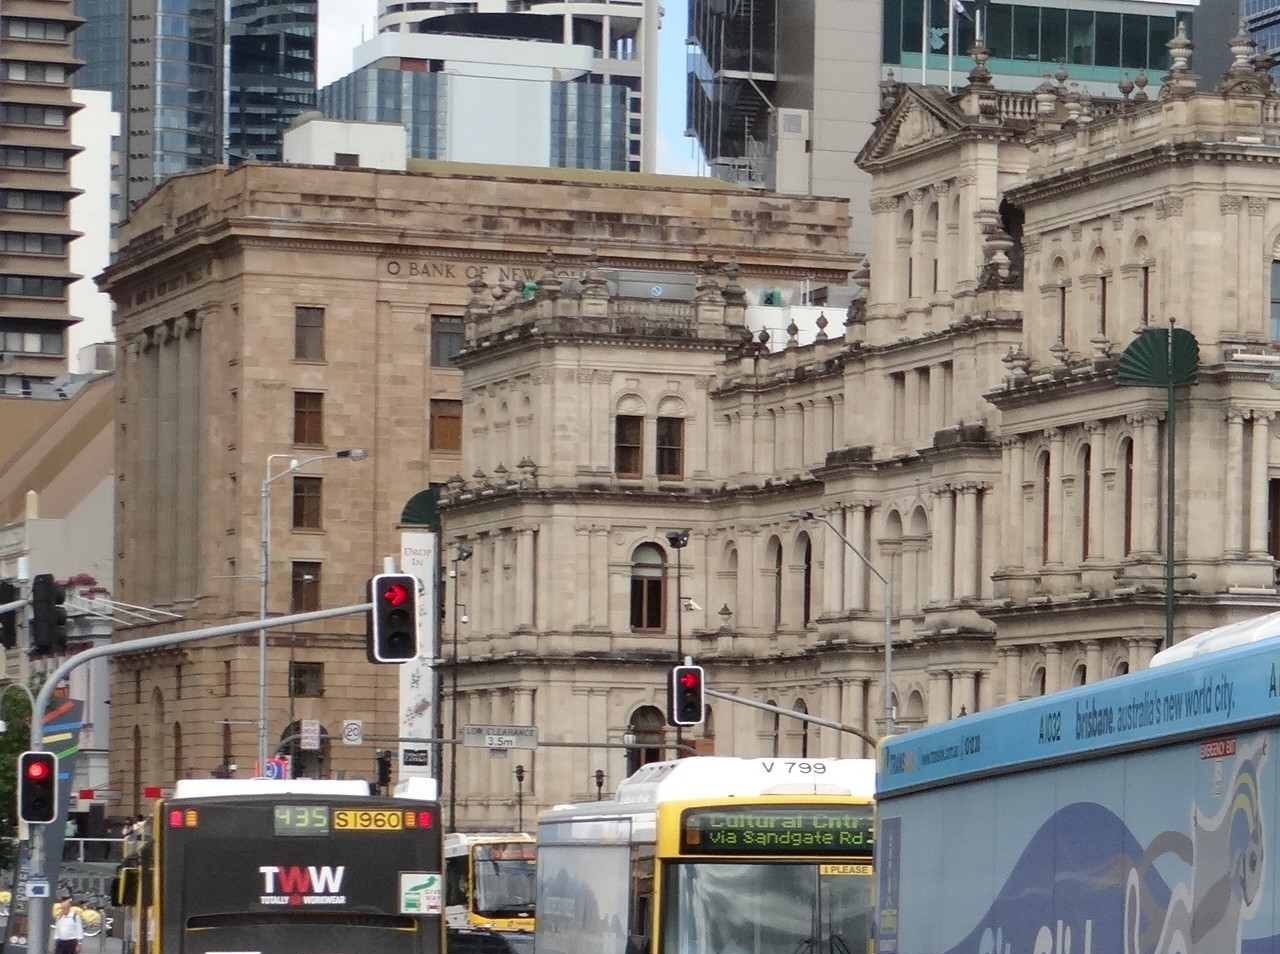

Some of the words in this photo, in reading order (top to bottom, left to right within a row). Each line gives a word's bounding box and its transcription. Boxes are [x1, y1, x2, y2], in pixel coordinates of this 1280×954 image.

[408, 262, 456, 278] BANK
[499, 267, 539, 281] NEW
[404, 548, 432, 557] DROP
[412, 558, 423, 566] IN
[1163, 692, 1182, 722] new
[1185, 676, 1212, 717] world
[346, 728, 359, 737] 20
[487, 728, 535, 737] CLEARANCE
[487, 737, 513, 746] 3.5m
[762, 762, 774, 773] V
[784, 762, 826, 774] 799
[275, 807, 327, 828] 435
[709, 831, 737, 844] via
[743, 830, 833, 845] Sandgate
[839, 831, 863, 845] Rd
[831, 866, 868, 874] PLEASE
[259, 866, 345, 893] TWW
[261, 896, 289, 904] TOTALLY
[303, 896, 345, 904] WORKWEAR
